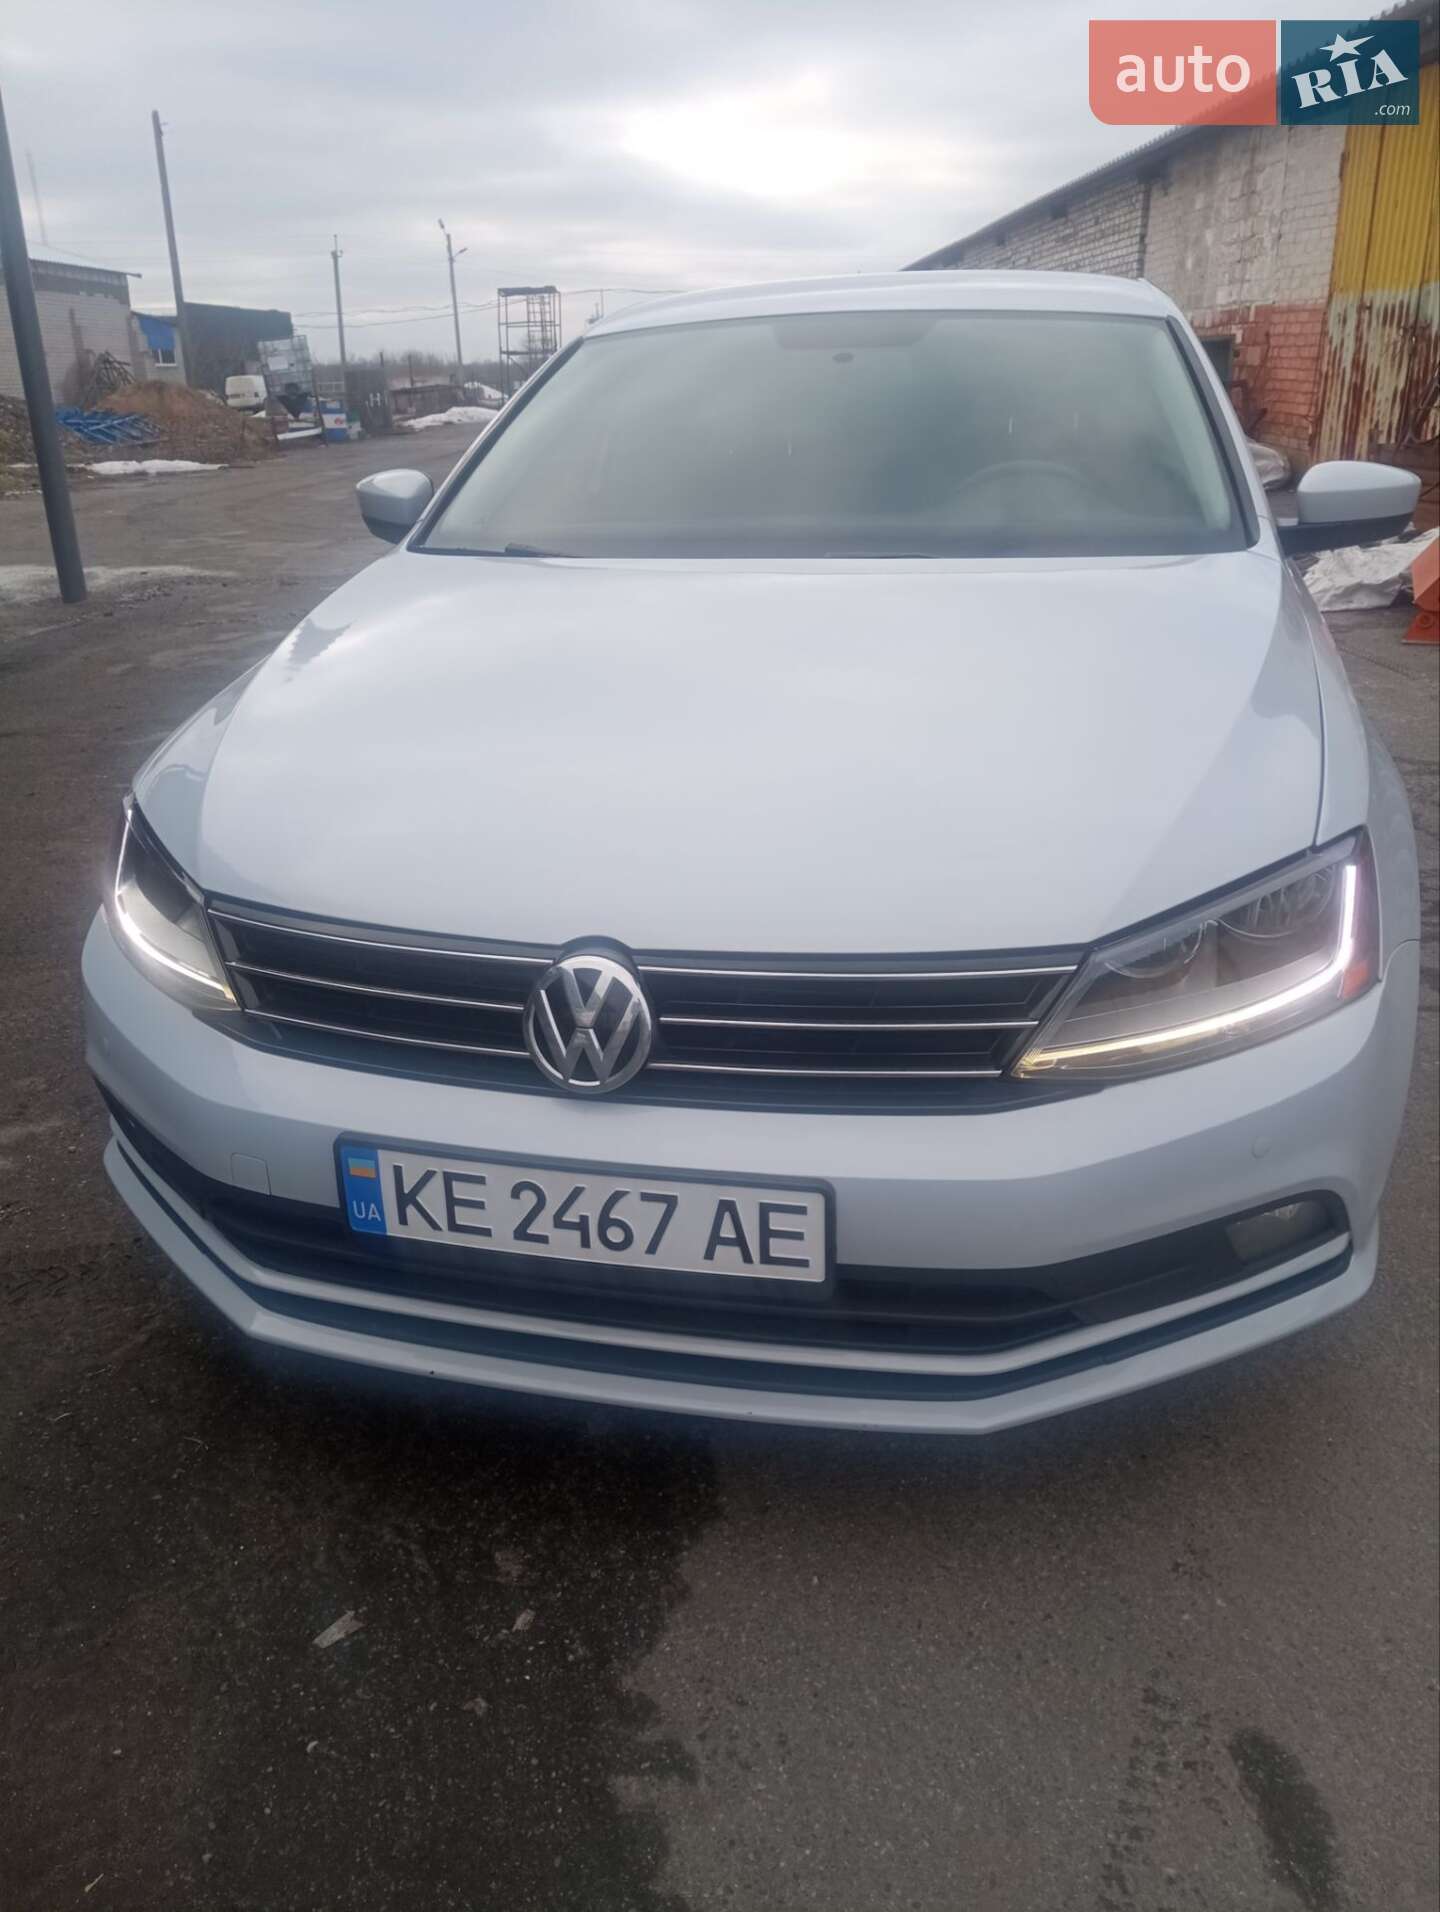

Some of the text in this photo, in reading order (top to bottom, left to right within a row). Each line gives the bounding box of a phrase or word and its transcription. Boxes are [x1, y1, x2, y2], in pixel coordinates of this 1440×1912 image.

[352, 1199, 382, 1223] UA
[393, 1163, 811, 1268] KE 2467 AE
